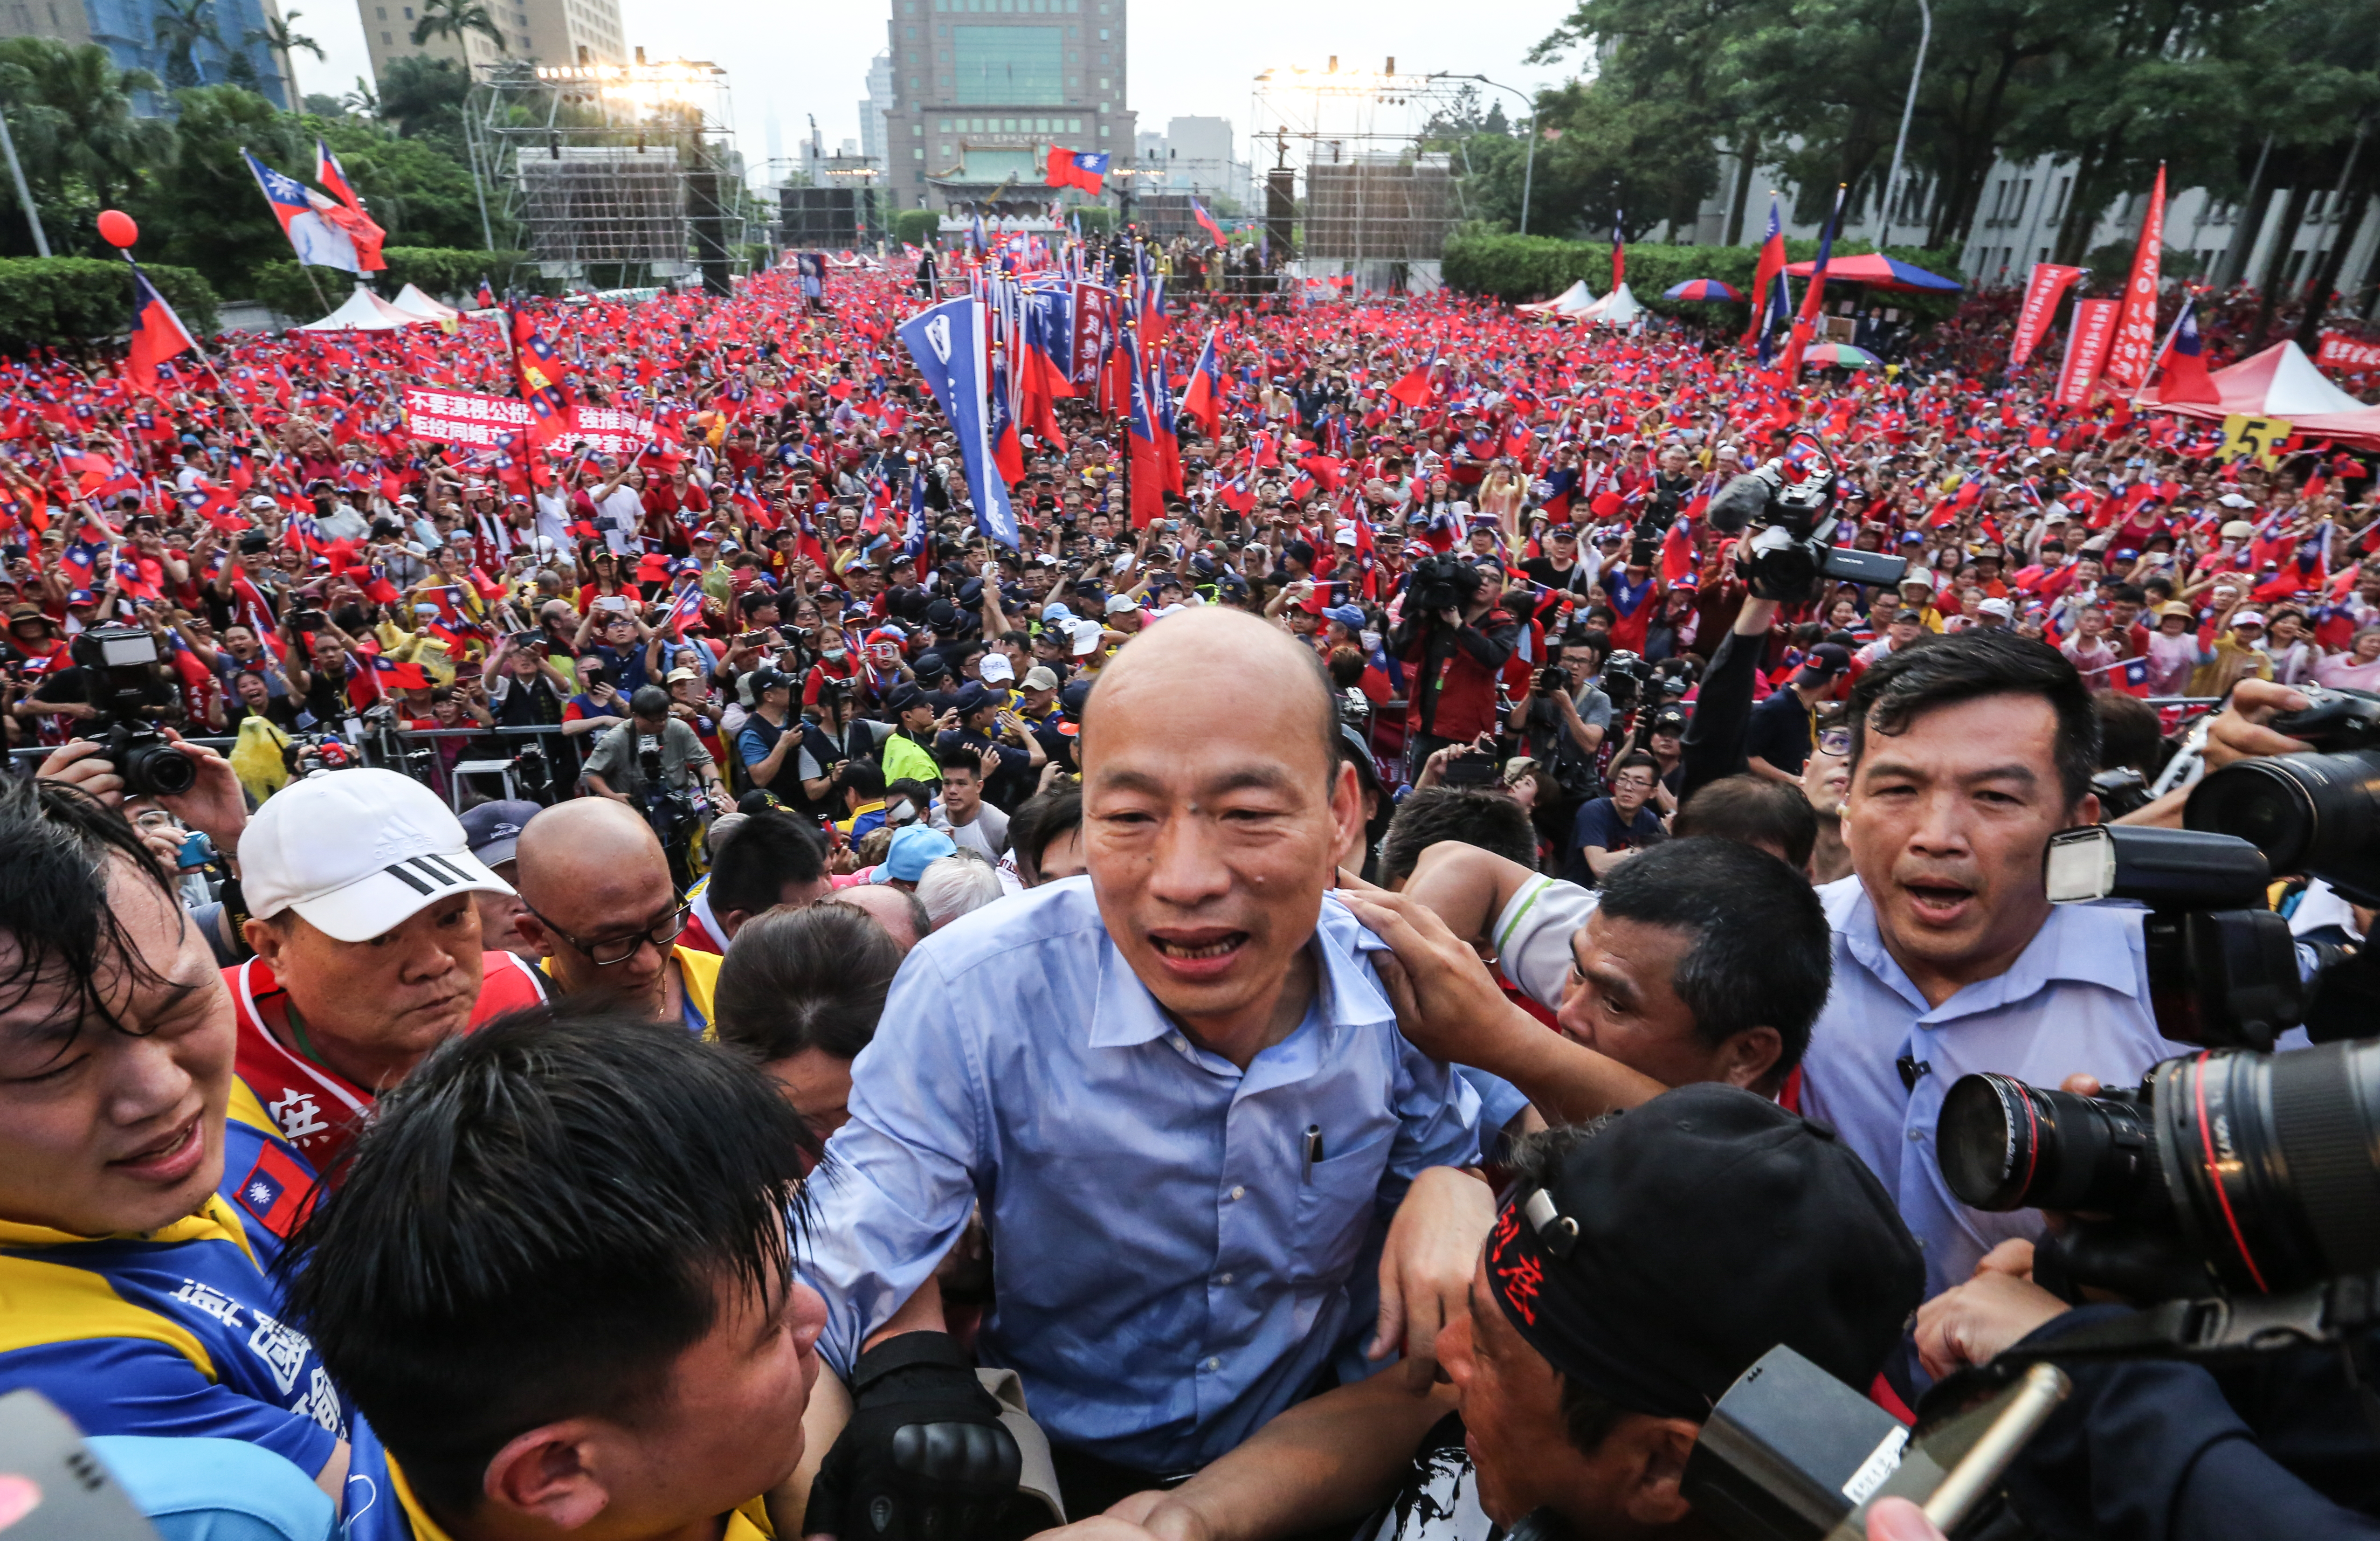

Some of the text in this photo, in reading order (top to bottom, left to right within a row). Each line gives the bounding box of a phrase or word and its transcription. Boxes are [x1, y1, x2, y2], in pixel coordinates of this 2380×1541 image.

[410, 414, 524, 445] 拒投同婚立
[546, 432, 648, 453] 支持愛家立
[2232, 421, 2267, 458] 5
[373, 835, 434, 860] adidas
